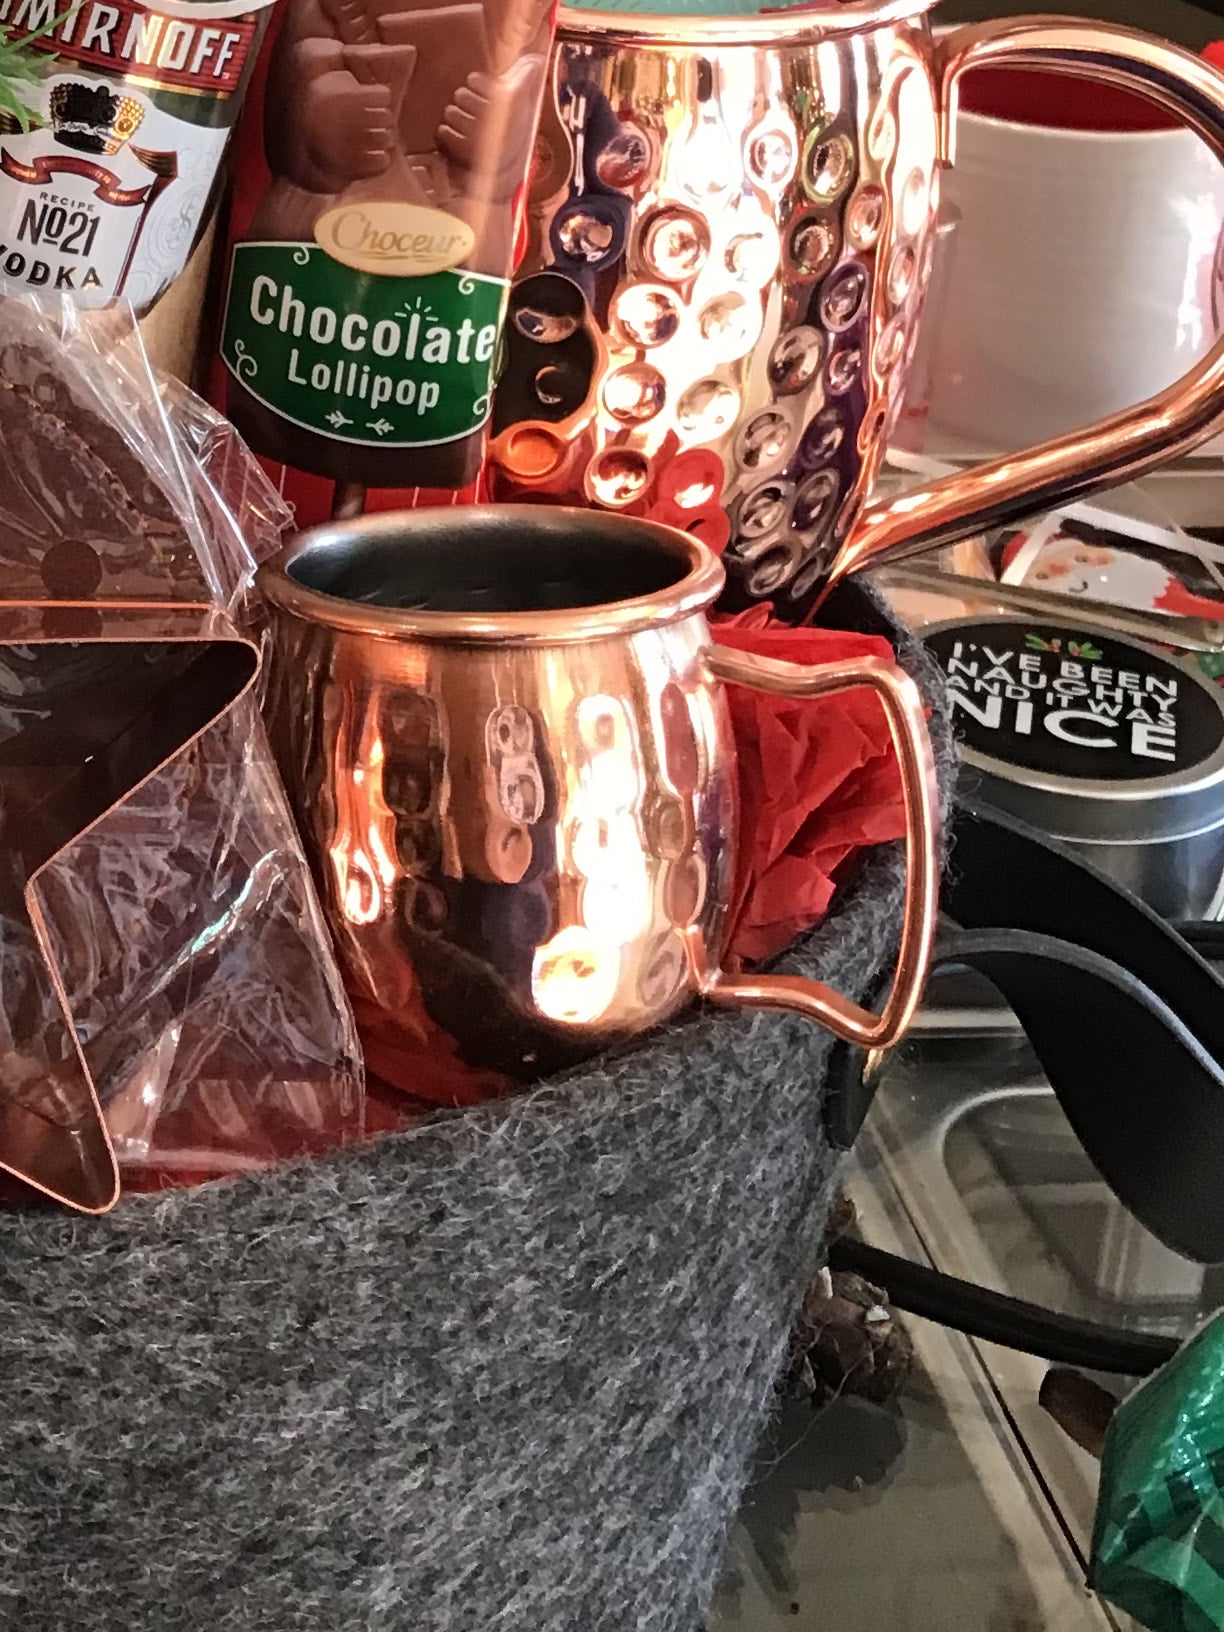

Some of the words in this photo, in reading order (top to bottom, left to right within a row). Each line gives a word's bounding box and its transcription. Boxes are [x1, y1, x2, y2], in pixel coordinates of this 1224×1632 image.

[39, 191, 96, 213] RECIPE
[330, 210, 466, 256] Choceur
[249, 274, 497, 365] Chocolate
[287, 348, 441, 416] Lollipop
[947, 658, 1178, 713] NAUGHTY
[952, 641, 1042, 673] I'VE
[1060, 660, 1178, 698] BEEN
[944, 675, 1031, 701] AND
[1045, 692, 1074, 708] IT
[1087, 698, 1177, 729] WAS
[945, 688, 1176, 762] NICE
